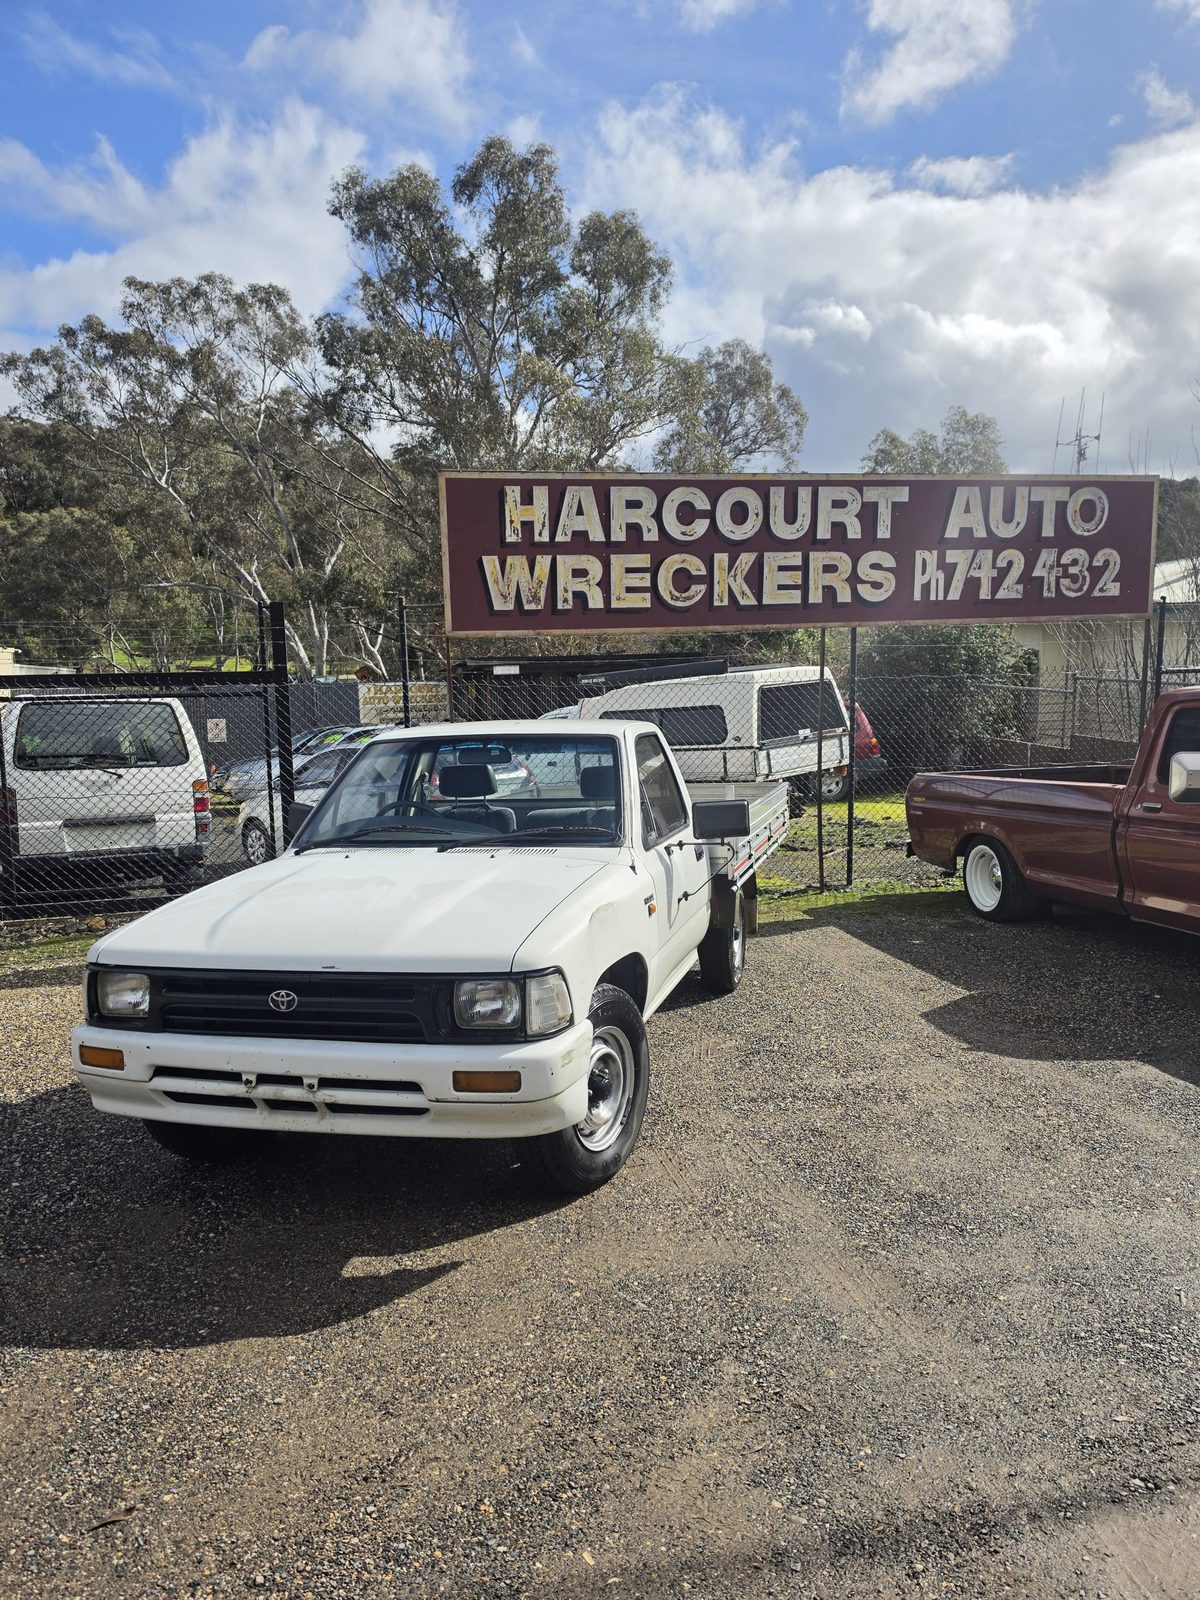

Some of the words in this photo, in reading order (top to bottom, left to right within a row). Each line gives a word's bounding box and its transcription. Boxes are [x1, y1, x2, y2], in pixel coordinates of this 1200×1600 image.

[503, 485, 909, 543] HARCOURT
[944, 486, 1109, 537] AUTO
[481, 550, 897, 611] WRECKERS
